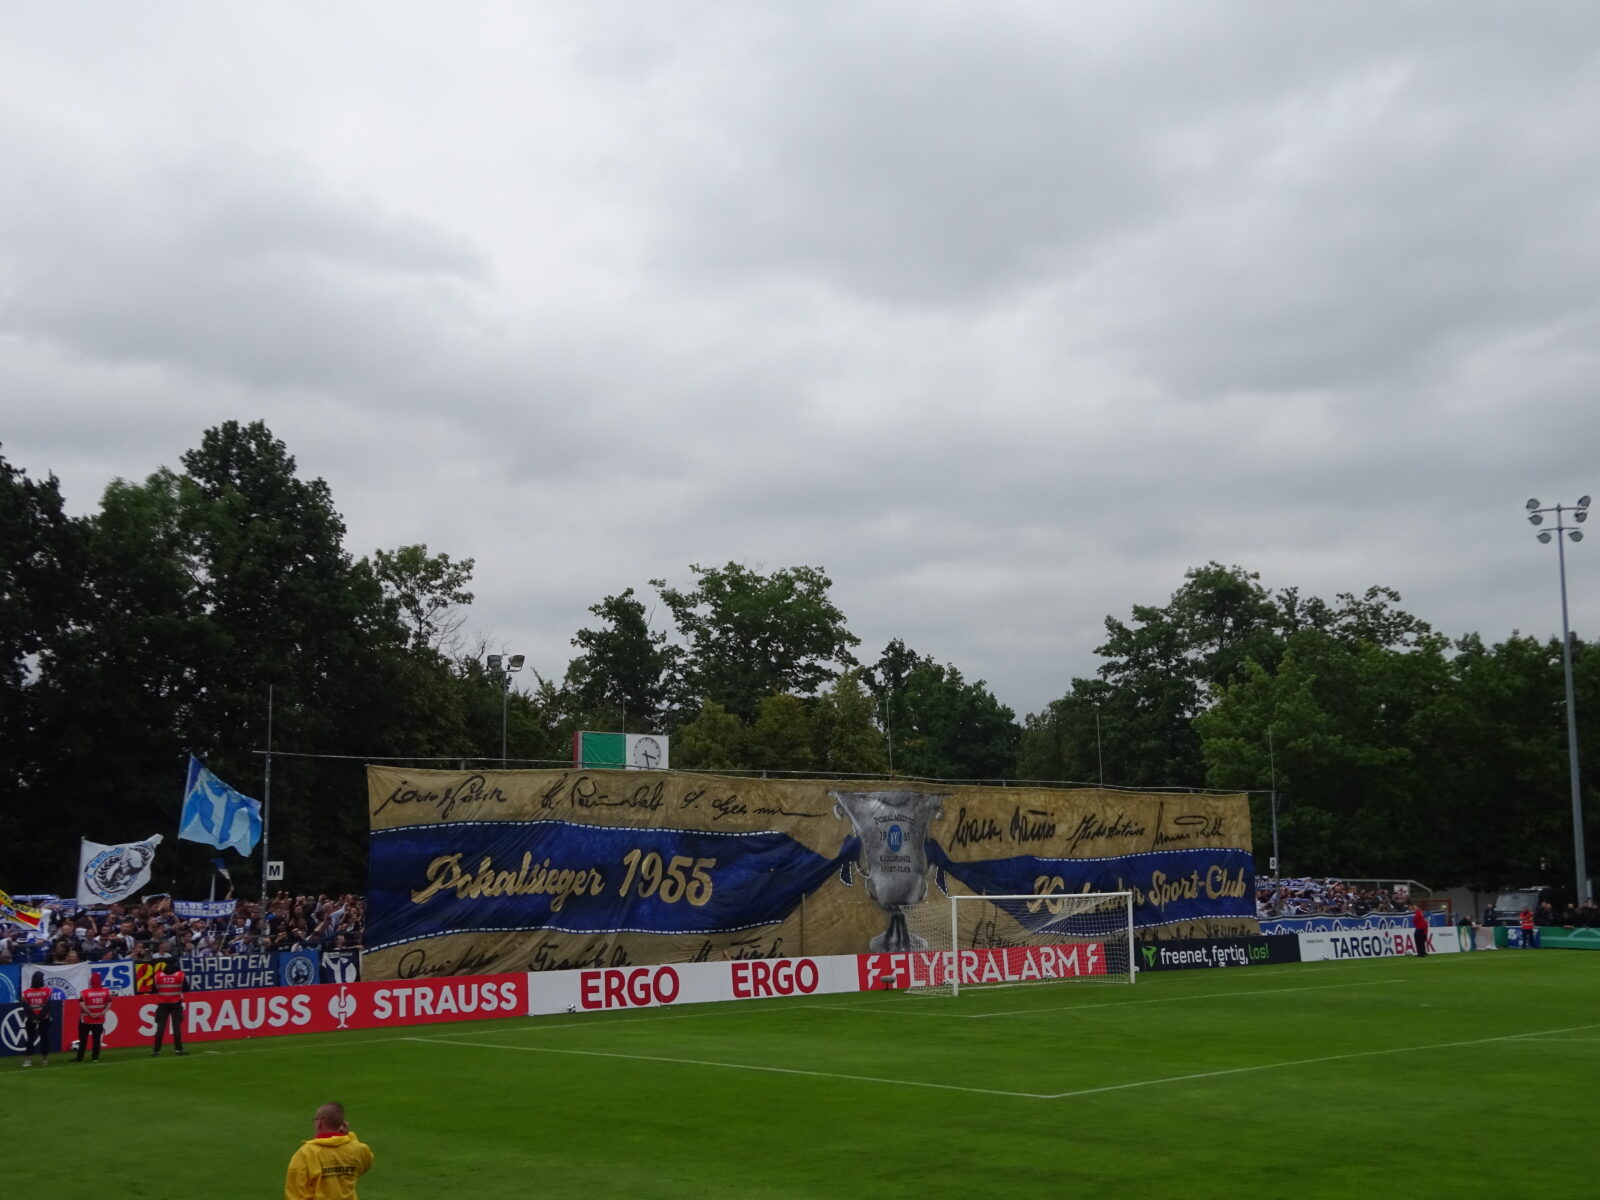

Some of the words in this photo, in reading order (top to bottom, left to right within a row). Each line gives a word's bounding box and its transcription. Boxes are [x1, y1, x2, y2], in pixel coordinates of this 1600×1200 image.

[270, 865, 281, 876] M
[411, 851, 605, 911] Pokalsieger
[619, 849, 717, 906] 1955
[1149, 865, 1247, 912] Sport-Club
[890, 945, 1079, 989] FLYERALARM
[1248, 942, 1269, 960] los!
[580, 966, 680, 1009] ERGO
[731, 959, 819, 998] ERGO
[373, 982, 518, 1019] STRAUSS
